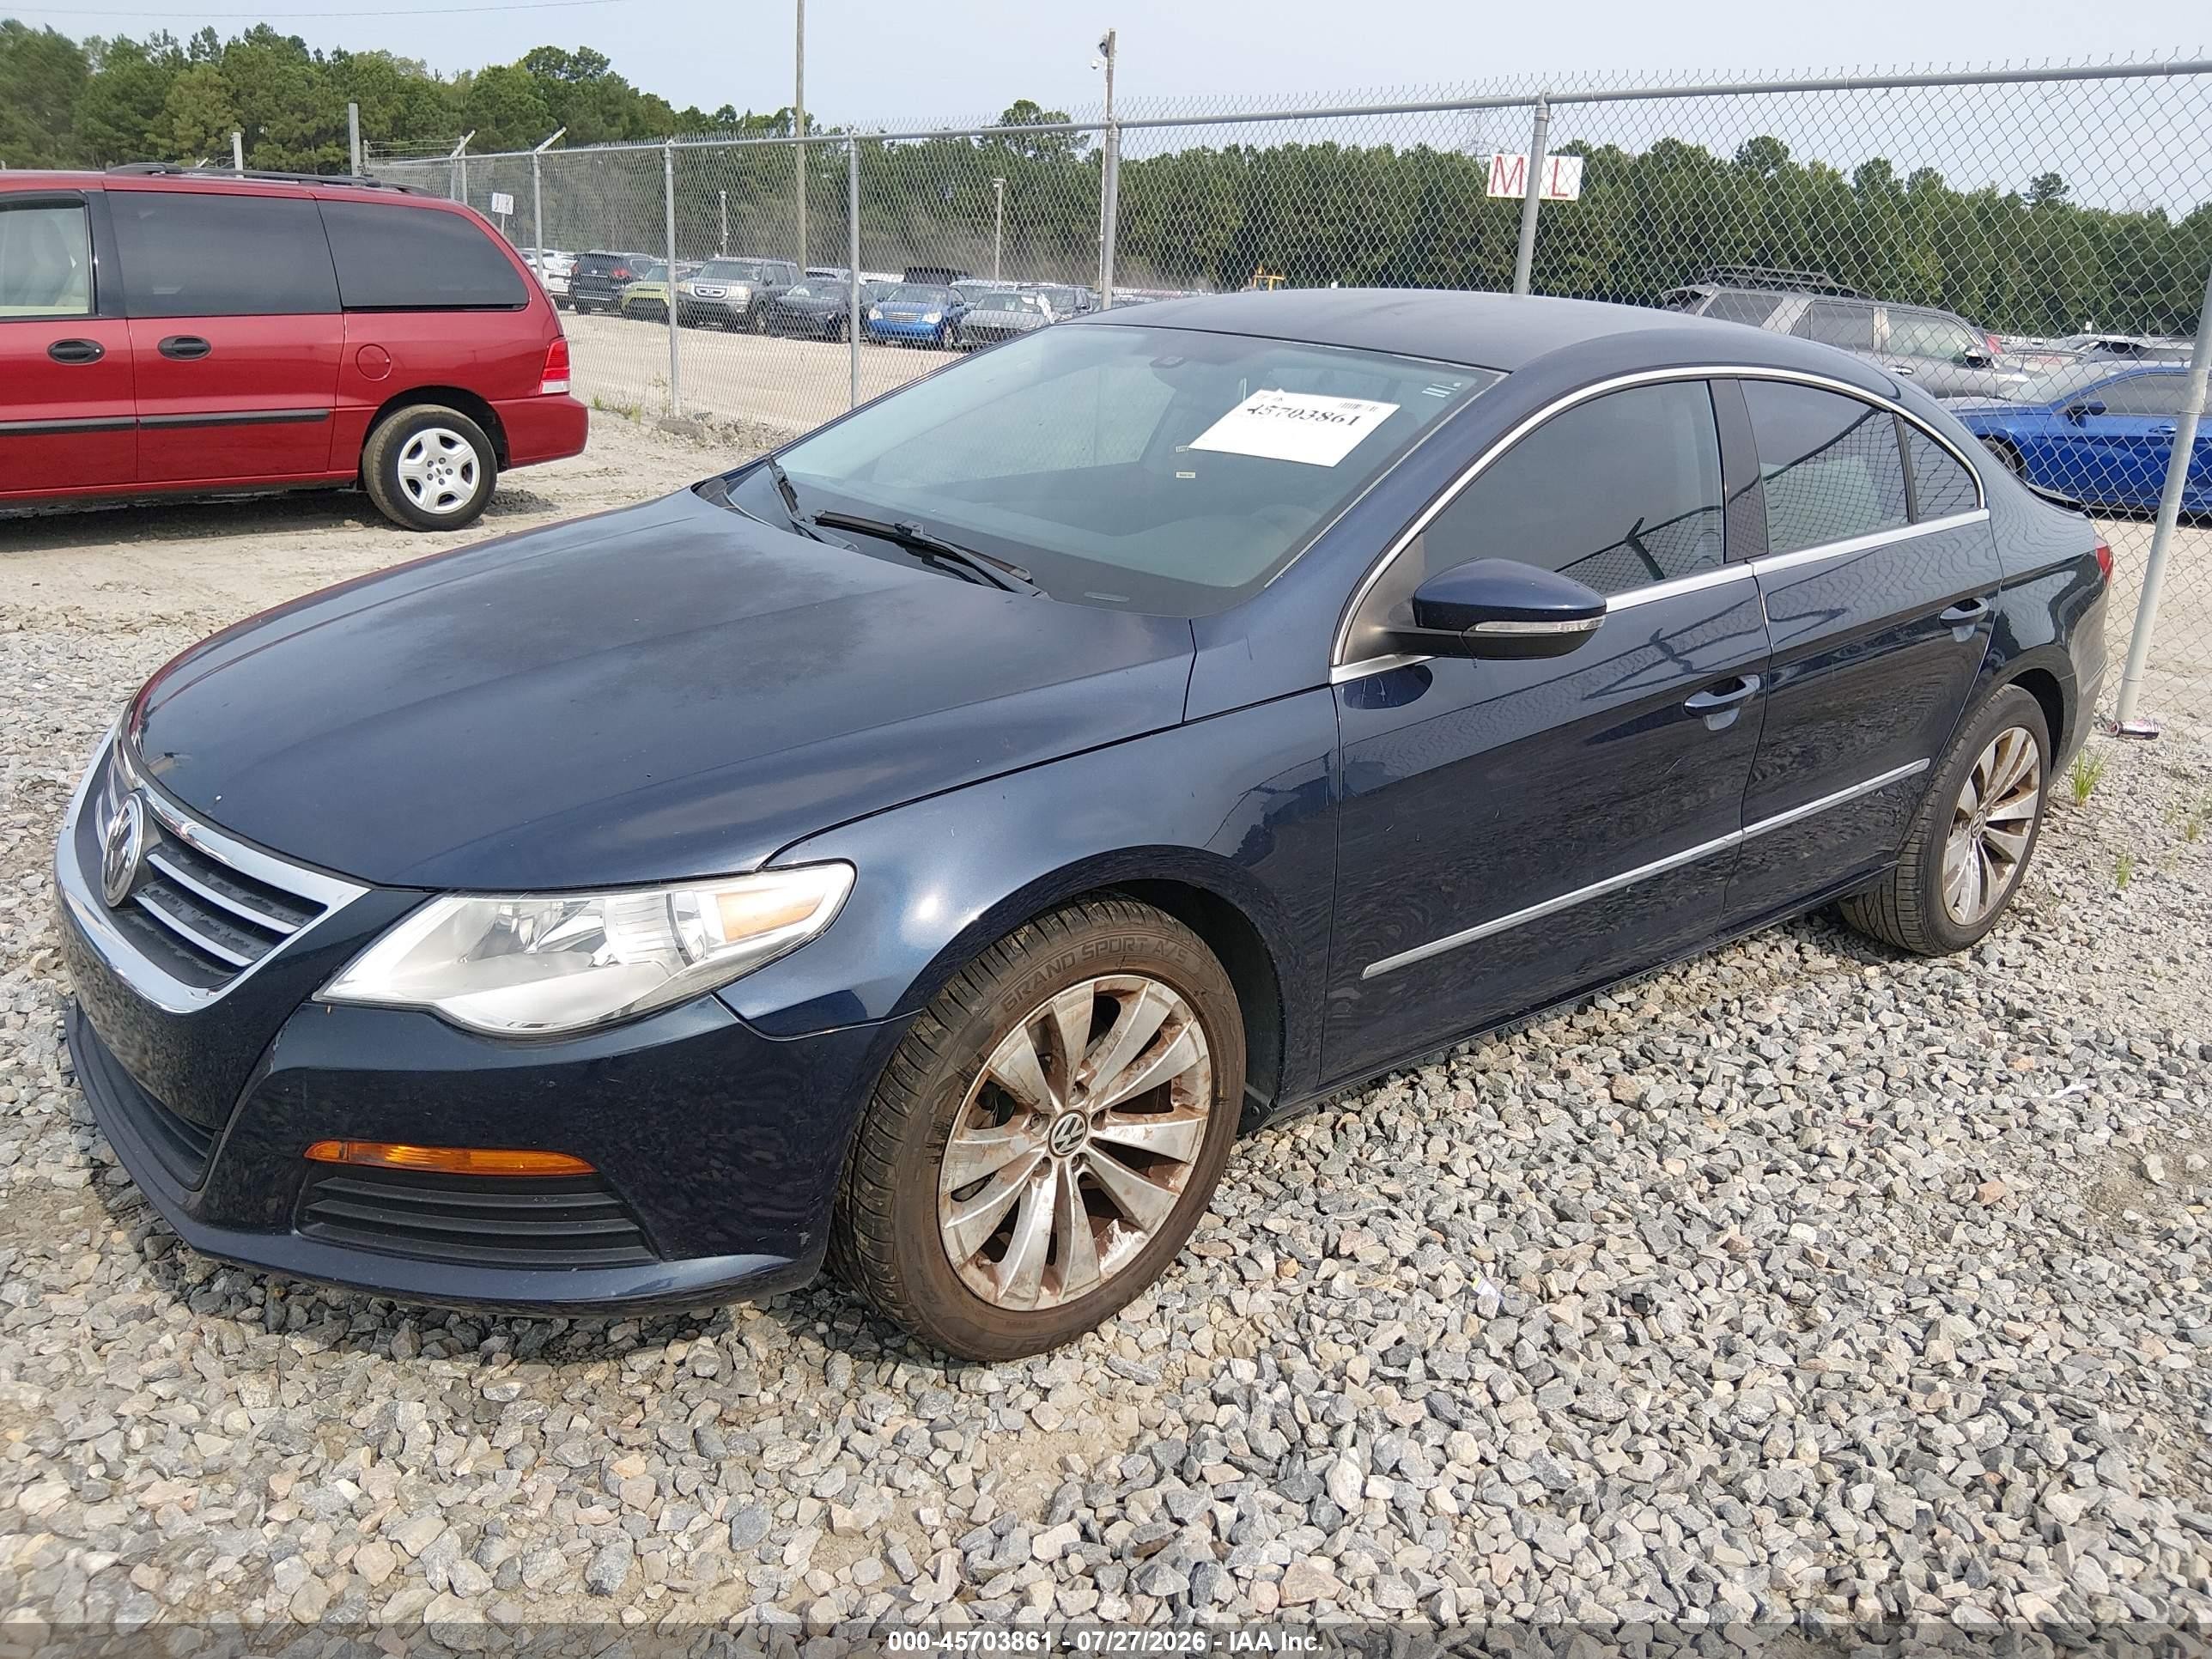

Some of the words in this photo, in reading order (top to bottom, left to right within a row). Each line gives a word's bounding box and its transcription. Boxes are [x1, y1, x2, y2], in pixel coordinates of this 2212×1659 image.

[1491, 155, 1524, 195] M
[1551, 158, 1569, 198] L
[1247, 404, 1361, 427] 45703861
[1000, 954, 1076, 1013] GRAND
[1081, 937, 1148, 962] SPORT
[1153, 939, 1188, 966] A/S
